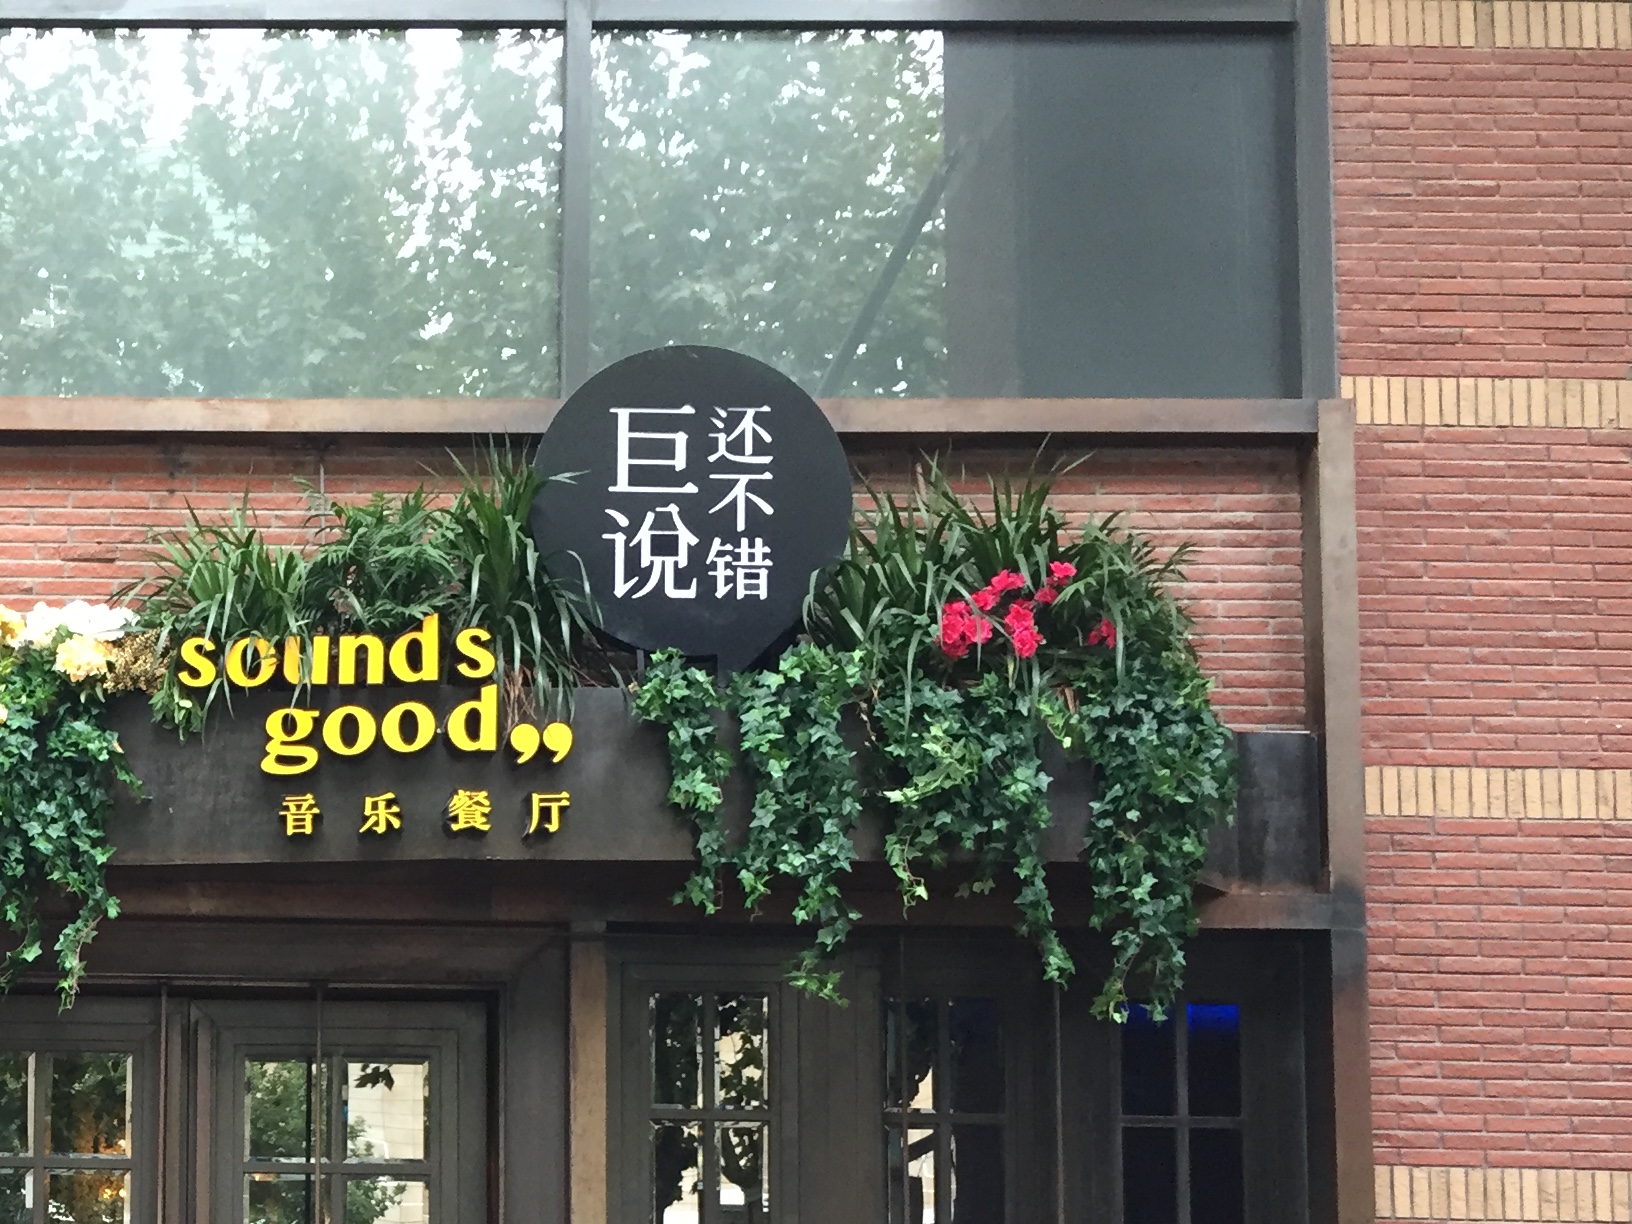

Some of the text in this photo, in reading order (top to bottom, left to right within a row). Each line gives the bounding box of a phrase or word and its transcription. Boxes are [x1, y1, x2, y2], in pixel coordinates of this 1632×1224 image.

[602, 404, 700, 600] 巨说
[705, 405, 774, 601] 还不错
[178, 613, 497, 688] sounds
[279, 789, 571, 836] 音乐餐厅
